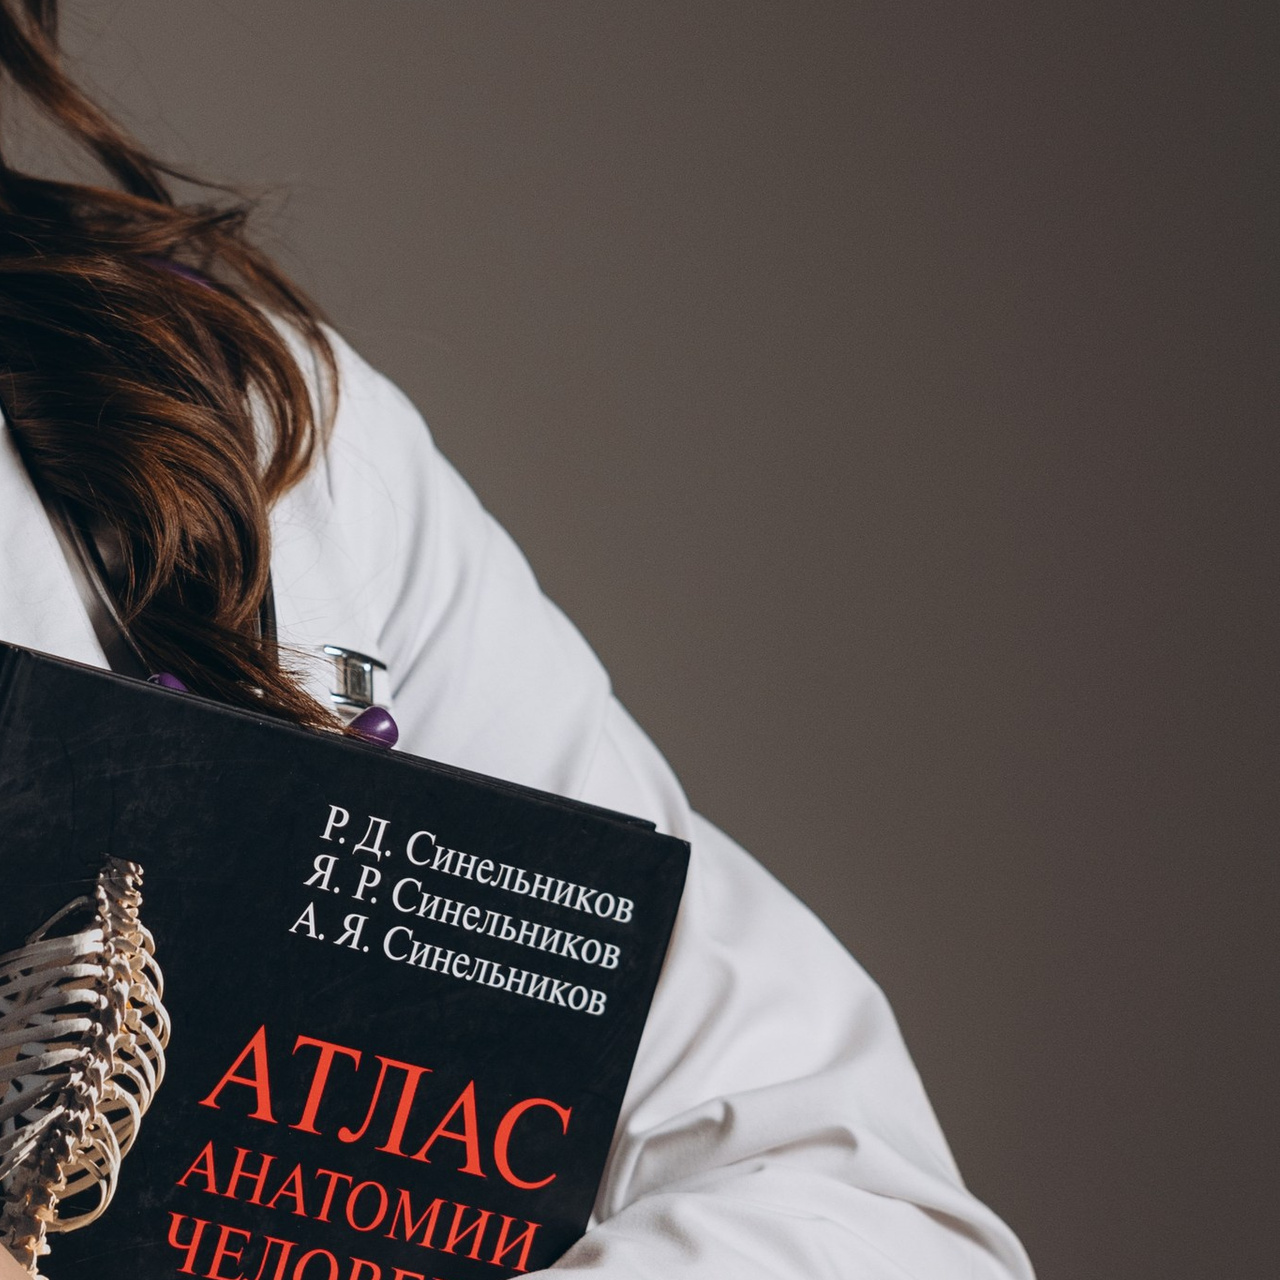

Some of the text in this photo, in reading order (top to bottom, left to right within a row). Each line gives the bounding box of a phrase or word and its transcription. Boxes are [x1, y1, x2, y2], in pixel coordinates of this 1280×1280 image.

[302, 854, 622, 970] Я. Р. Синельников
[319, 804, 635, 924] Р. Д. Синельников
[288, 901, 608, 1016] А. Я. Синельников
[198, 1024, 572, 1190] АТЛАС
[176, 1140, 543, 1273] АНАТОМИИ
